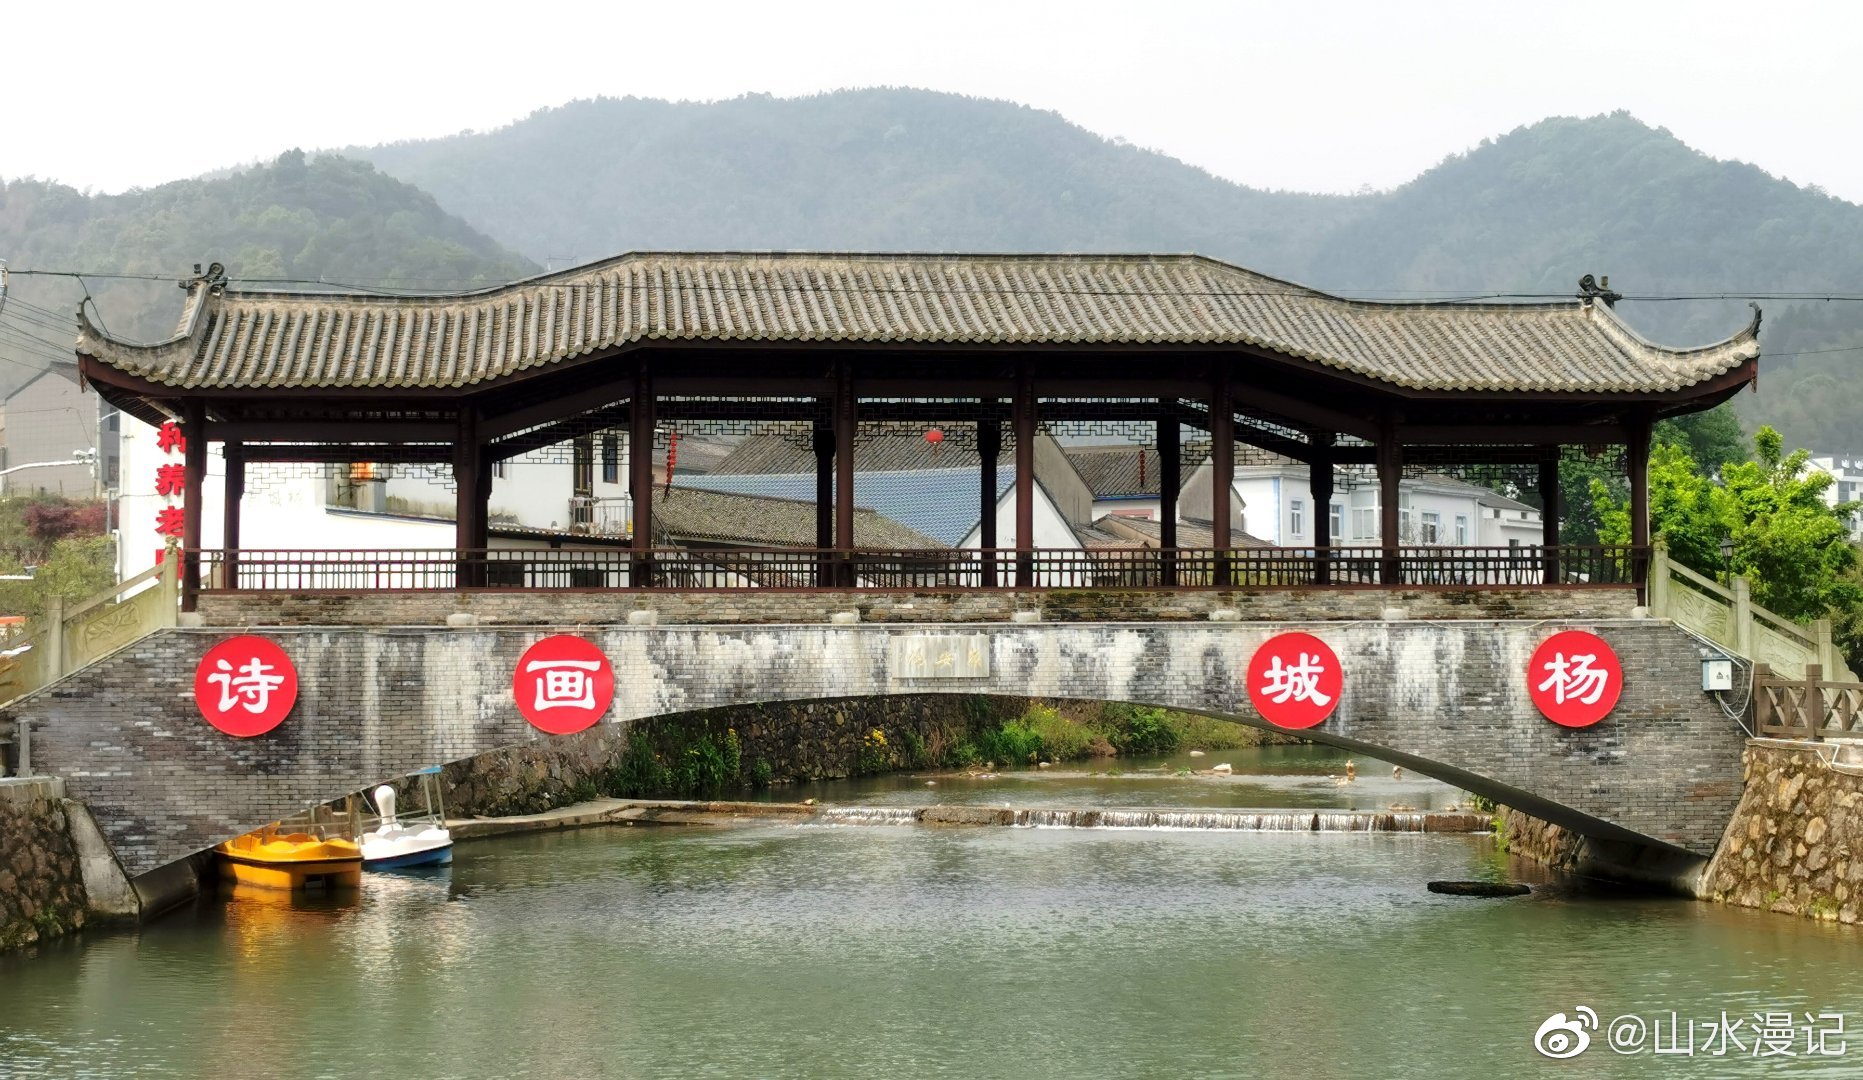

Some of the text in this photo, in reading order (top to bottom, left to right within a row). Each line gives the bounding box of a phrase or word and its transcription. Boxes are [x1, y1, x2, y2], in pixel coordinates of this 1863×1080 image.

[207, 658, 284, 713] 诗
[526, 661, 600, 711] 画
[1261, 653, 1331, 706] 城
[1538, 653, 1608, 704] 杨
